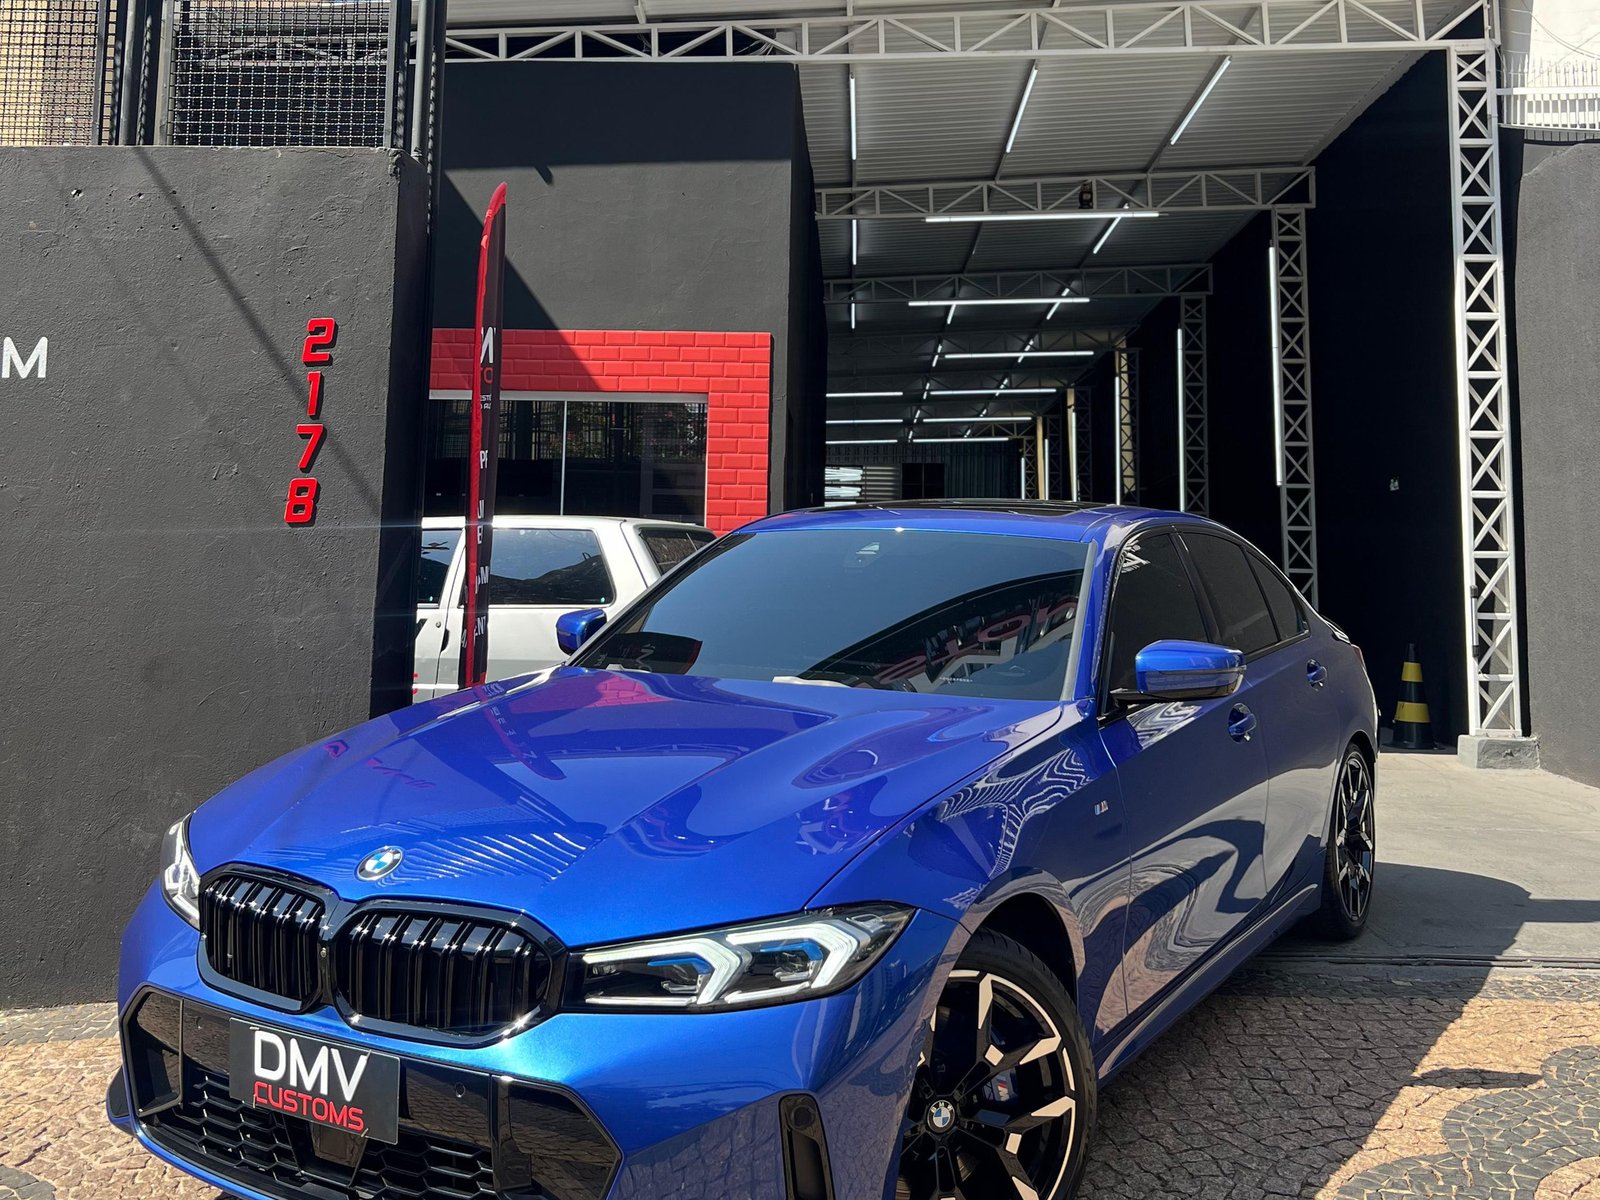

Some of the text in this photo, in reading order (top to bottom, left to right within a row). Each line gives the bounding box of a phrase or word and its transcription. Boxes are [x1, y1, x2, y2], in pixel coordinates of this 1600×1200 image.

[2, 336, 48, 379] M
[284, 317, 336, 523] 2178
[254, 1030, 367, 1102] DMV
[253, 1081, 365, 1132] CUSTOMS
